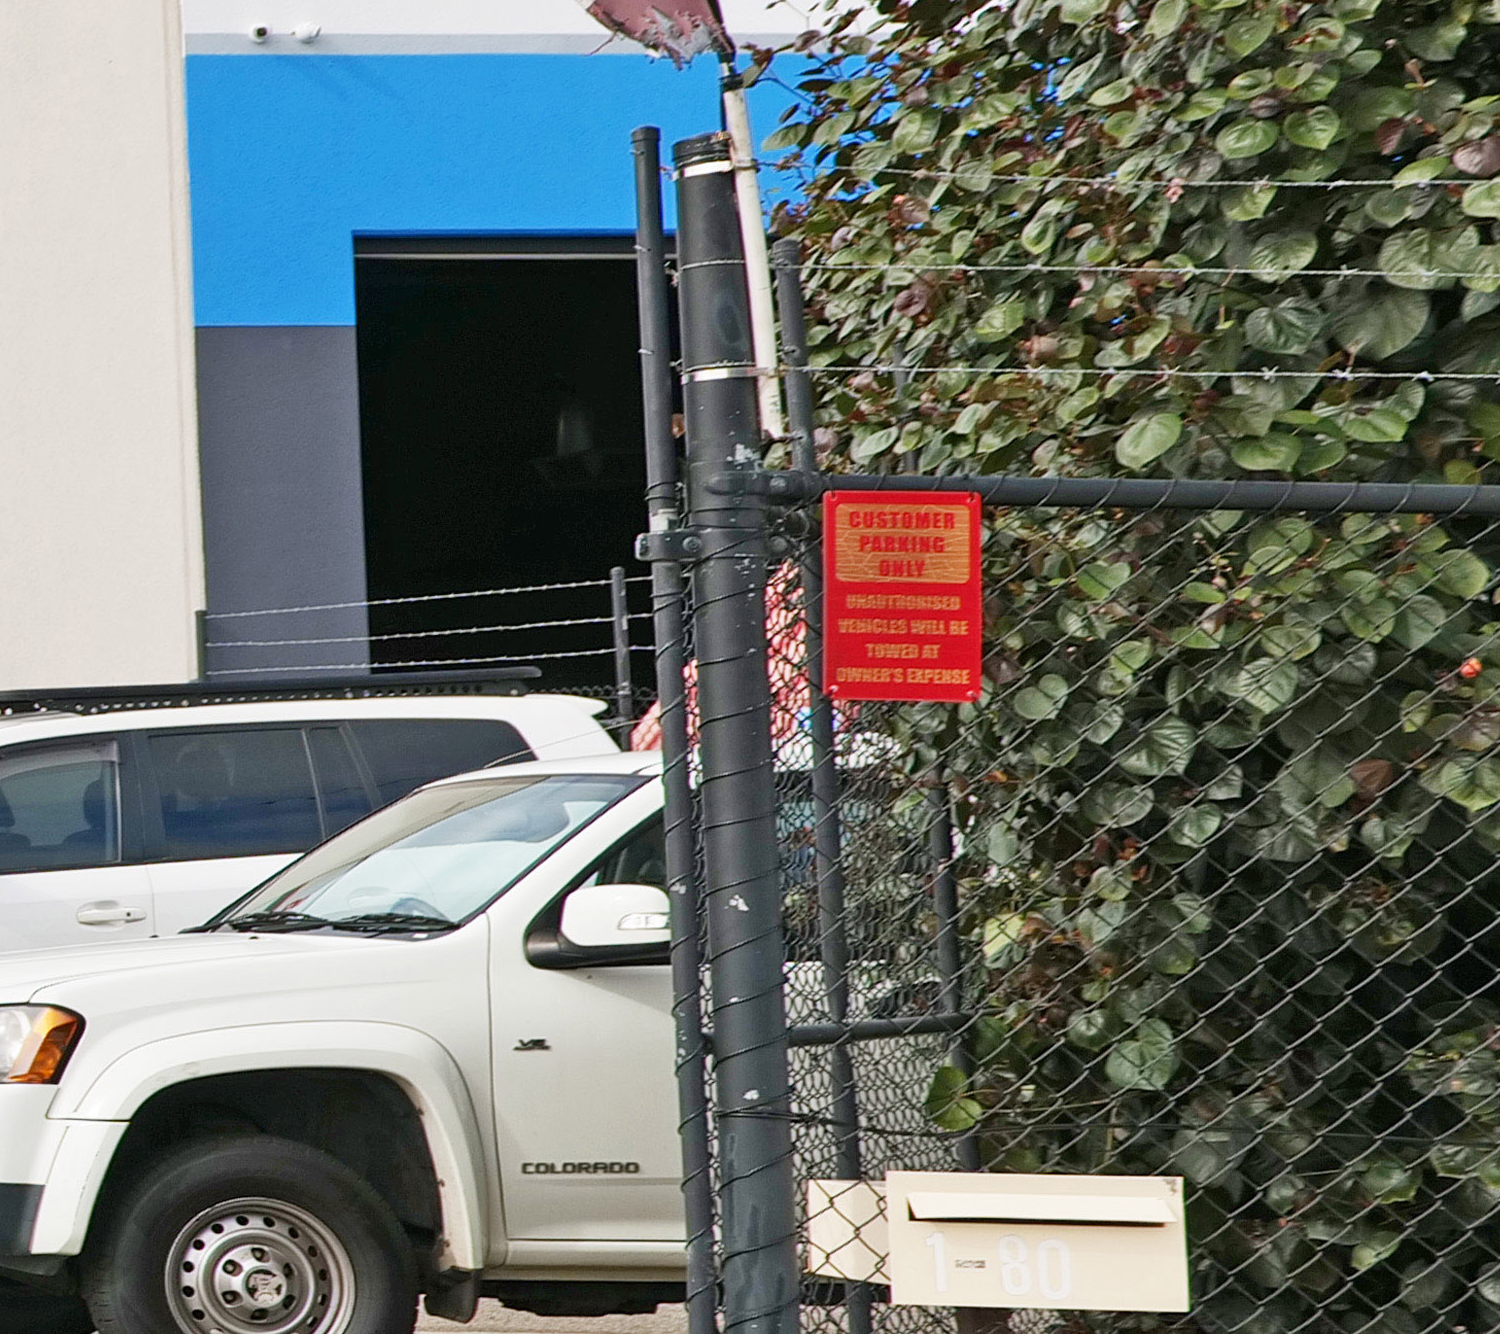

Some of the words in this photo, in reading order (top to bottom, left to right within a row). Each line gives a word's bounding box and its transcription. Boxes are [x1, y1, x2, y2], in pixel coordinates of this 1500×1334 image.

[849, 511, 956, 529] CUSTOMER
[859, 535, 946, 553] PARKING
[878, 559, 926, 577] ONLY
[845, 594, 961, 611] UNAUTHORISED
[837, 618, 908, 634] VEHICLES
[910, 619, 947, 635] WILL
[949, 620, 969, 636] BE
[865, 643, 920, 659] TOWED
[921, 644, 941, 659] AT
[835, 667, 904, 683] OWNER'S
[905, 667, 971, 685] EXPENSE
[521, 1161, 640, 1175] COLORADO
